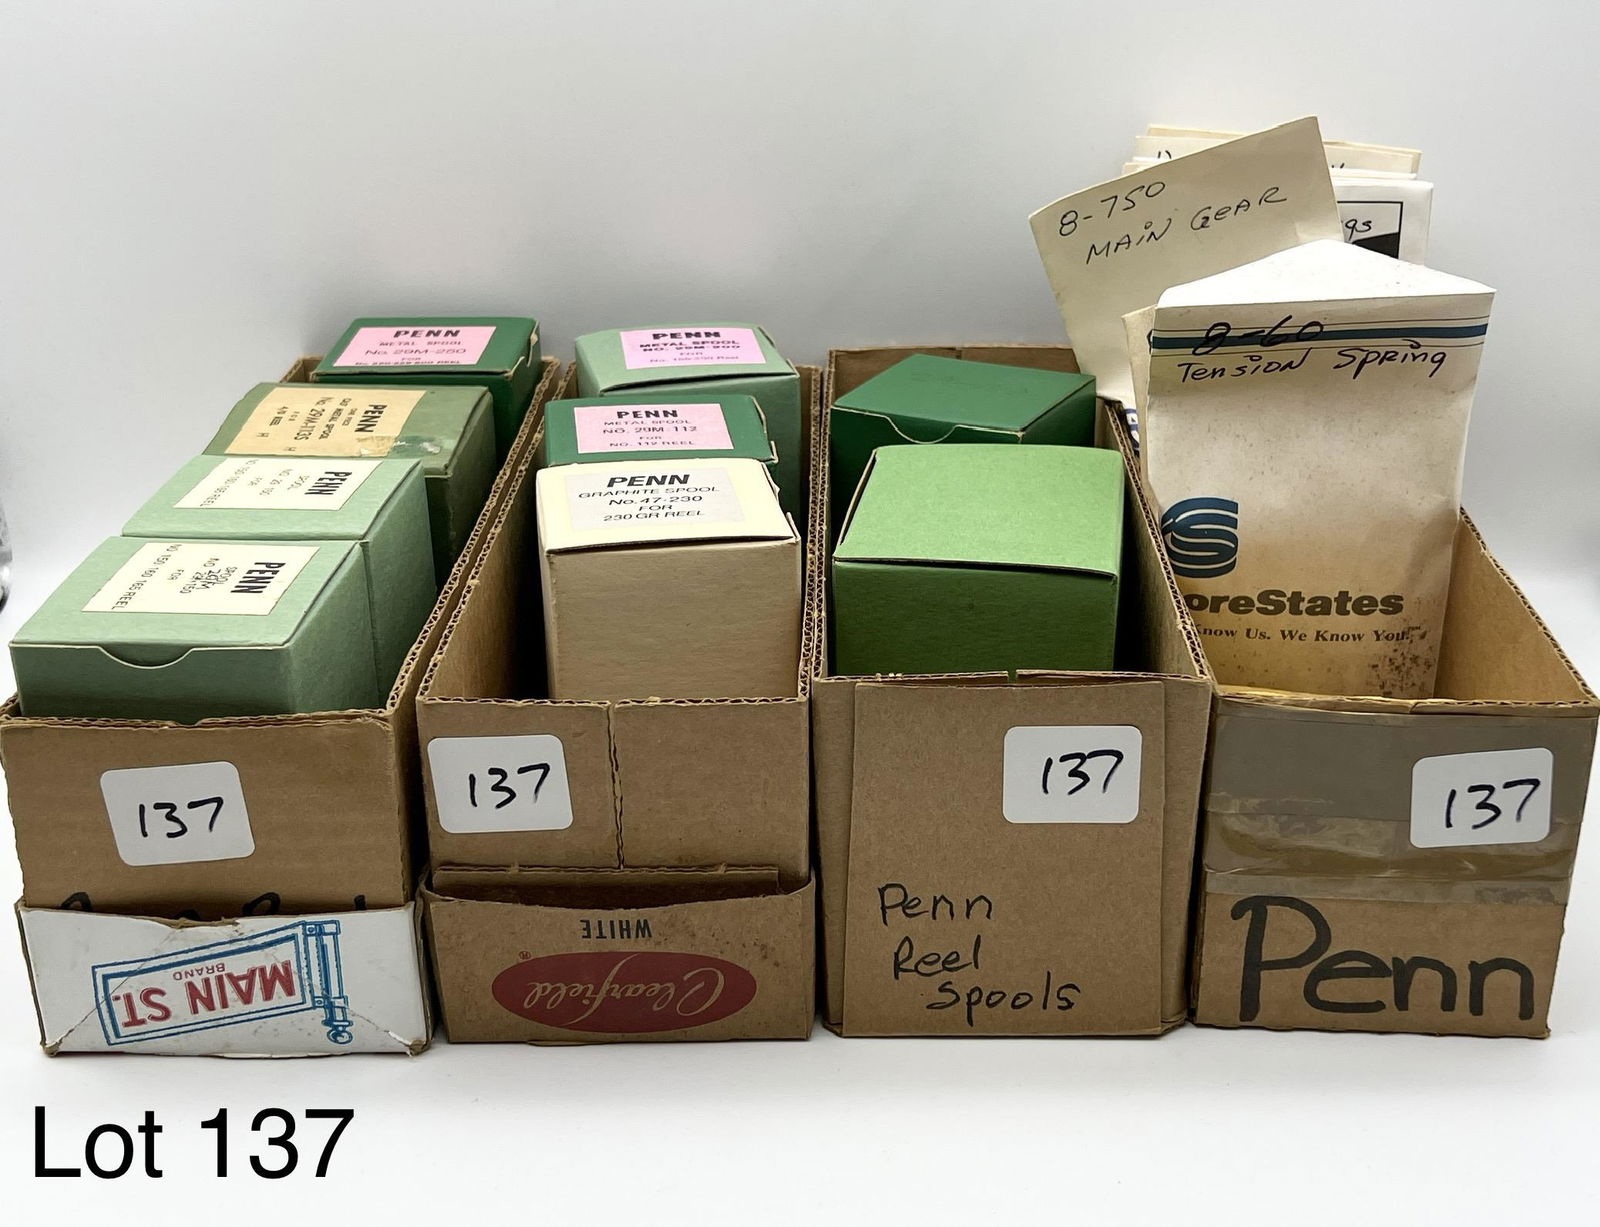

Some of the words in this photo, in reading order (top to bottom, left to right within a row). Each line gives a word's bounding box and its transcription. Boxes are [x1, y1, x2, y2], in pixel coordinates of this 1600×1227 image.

[1059, 182, 1166, 238] 8-750
[393, 329, 461, 338] PENN
[652, 331, 721, 340] PENN
[1192, 315, 1324, 355] 8-60
[354, 404, 387, 433] PENN
[616, 409, 679, 419] PENN
[304, 471, 353, 495] PENN
[578, 488, 660, 498] GRAPHITE
[665, 486, 721, 494] SPOOL
[607, 474, 690, 487] PENN
[603, 513, 633, 522] 230
[664, 510, 705, 518] REEL
[139, 567, 160, 577] 160
[151, 554, 172, 565] 150
[126, 579, 147, 590] 165
[167, 569, 185, 581] FOR
[218, 566, 238, 585] SPOOL
[230, 562, 286, 594] PENN
[111, 591, 137, 610] REEL
[1184, 589, 1404, 617] oreStates
[1245, 628, 1271, 640] Us.
[1280, 629, 1307, 642] We
[1314, 630, 1365, 642] Know
[469, 762, 551, 809] 137
[1042, 749, 1124, 796] 137
[1444, 778, 1541, 830] 137
[139, 796, 224, 839] 137
[877, 882, 993, 926] Penn
[580, 918, 653, 939] WHITE
[893, 934, 982, 981] Reel
[1231, 895, 1535, 1022] Penn
[172, 962, 226, 981] BRAND
[185, 959, 297, 1015] MAIN
[523, 953, 726, 1026] Clearfield
[926, 970, 1081, 1027] Spools
[112, 987, 173, 1028] ST.
